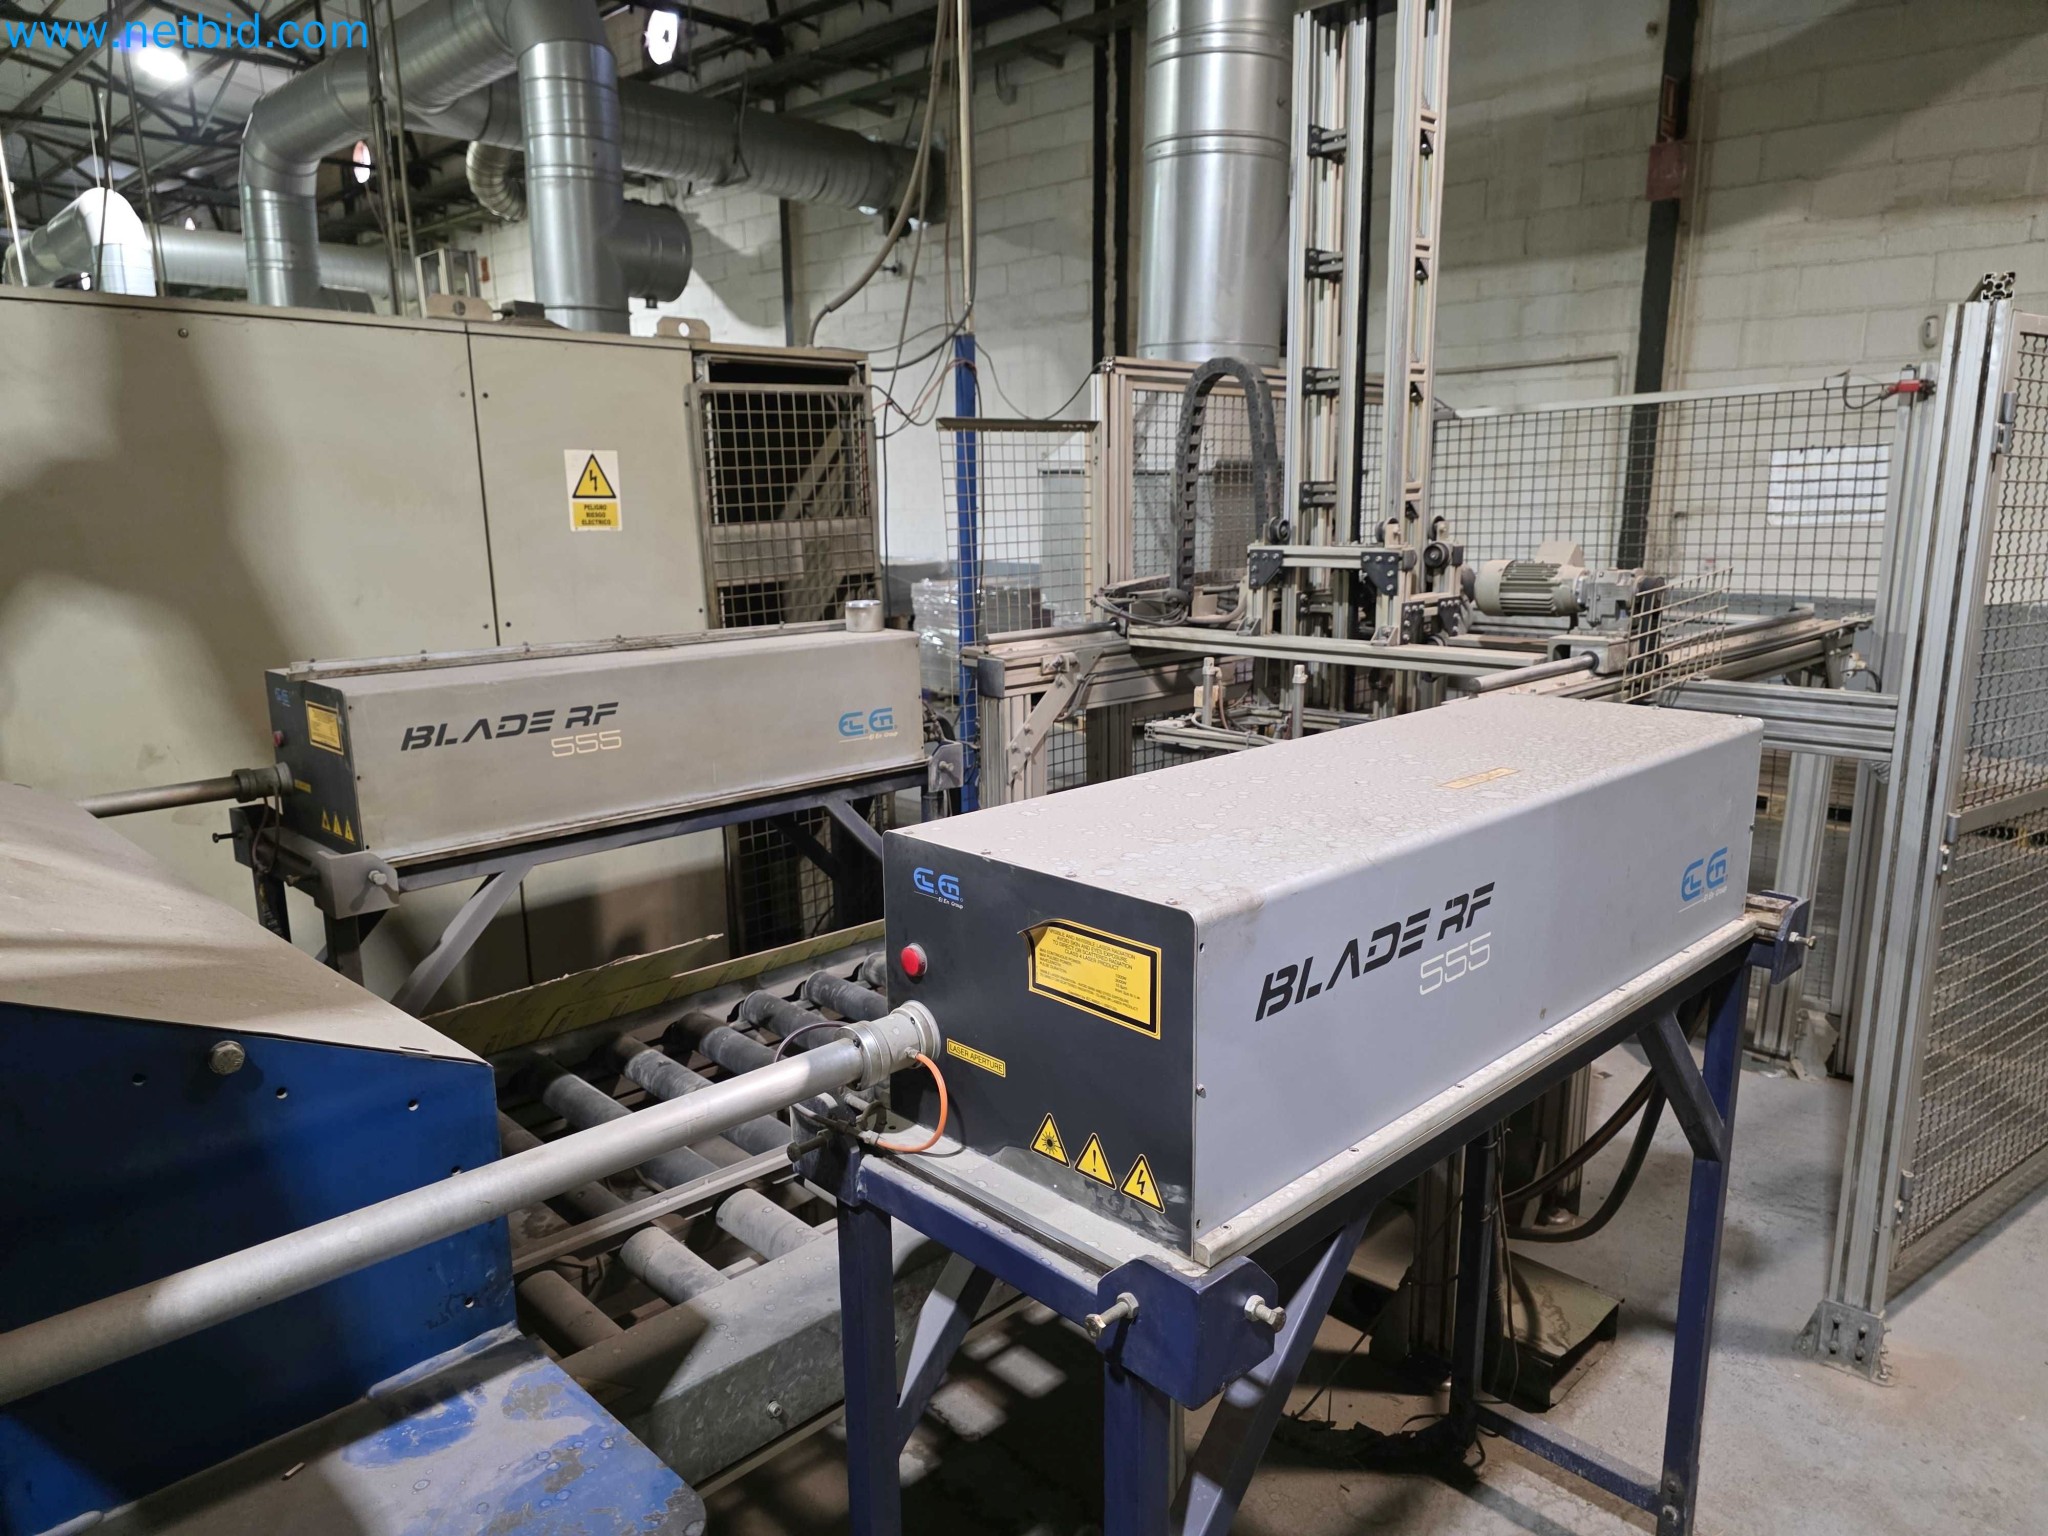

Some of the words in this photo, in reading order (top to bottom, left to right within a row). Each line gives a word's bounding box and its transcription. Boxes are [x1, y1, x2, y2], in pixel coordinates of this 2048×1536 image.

[401, 709, 556, 751] BLADE
[565, 702, 619, 729] RF
[1057, 936, 1069, 944] AVOID
[1104, 951, 1128, 963] EXPOSURE
[1059, 942, 1074, 951] DIRECT
[1082, 949, 1108, 962] SCATTERED
[1109, 958, 1132, 970] RADIATION
[1065, 949, 1078, 958] CLASS
[1083, 955, 1096, 964] LASER
[1098, 960, 1119, 971] PRODUCT
[1097, 943, 1110, 951] LASER
[1111, 948, 1135, 960] RADIATION
[1255, 908, 1431, 1022] BLADE
[1437, 882, 1496, 941] RF
[949, 1043, 969, 1058] LASER
[970, 1054, 1003, 1073] APERTURE
